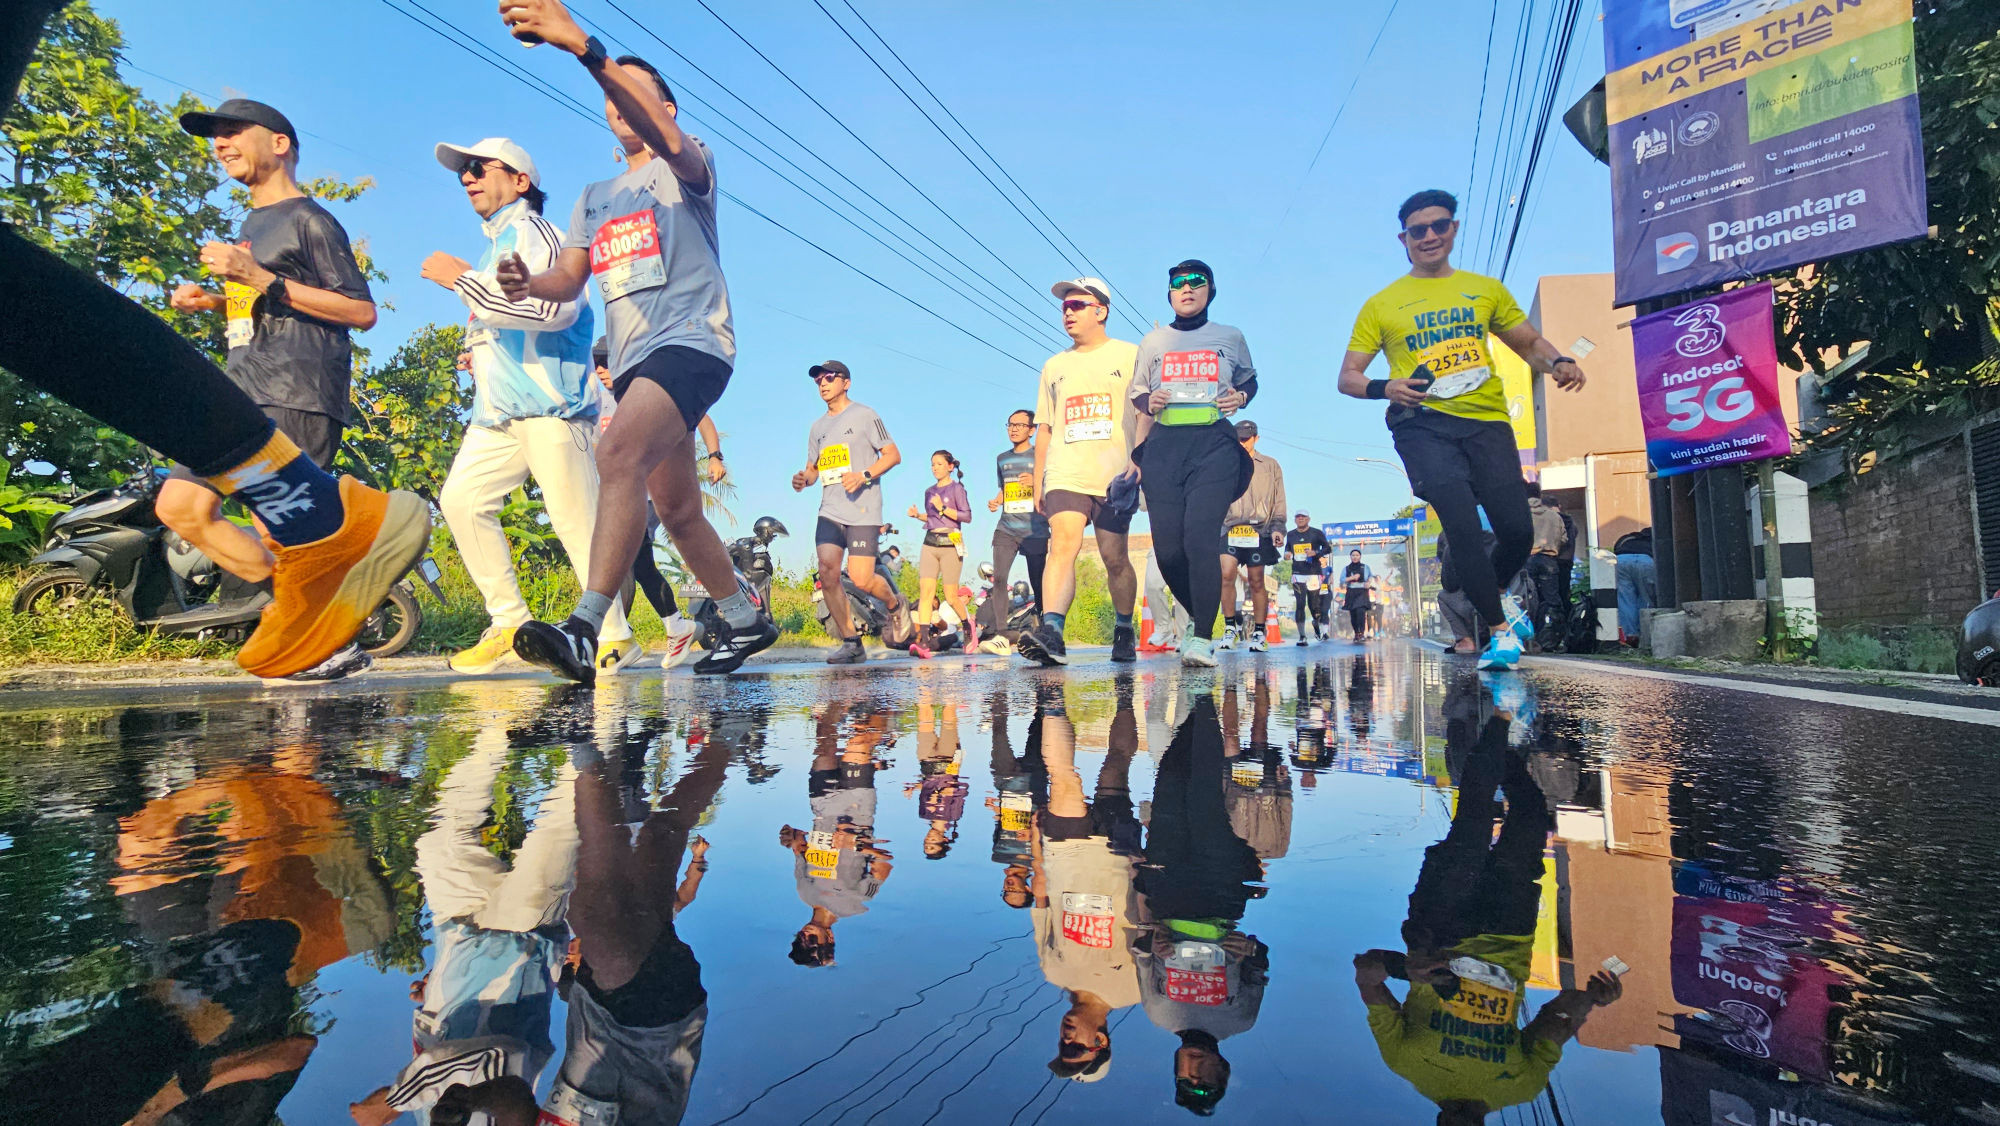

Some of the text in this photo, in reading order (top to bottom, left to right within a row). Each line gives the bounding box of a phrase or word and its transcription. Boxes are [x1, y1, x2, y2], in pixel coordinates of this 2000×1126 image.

[1641, 35, 1741, 85] MORE
[1754, 0, 1862, 40] THAN
[1668, 22, 1832, 94] A RACE
[1783, 123, 1876, 156] mandiri call 14000
[1774, 143, 1866, 175] bankmandiri.co.id
[1657, 161, 1746, 194] Livin' Call by Mandiri
[1670, 194, 1692, 206] MITA
[1693, 189, 1709, 199] 081
[1730, 176, 1755, 188] 4000
[611, 215, 650, 234] 10K-M
[1707, 187, 1867, 242] Danantara
[593, 228, 654, 265] A30085
[1708, 211, 1857, 262] Indonesia
[1414, 306, 1475, 331] VEGAN
[1405, 323, 1484, 352] RUNNERS
[1164, 361, 1217, 377] B31160
[1663, 355, 1744, 387] indosat
[1067, 403, 1111, 420] B31746
[1665, 377, 1755, 432] 5G
[1671, 433, 1767, 460] kini sudah hadir
[1690, 448, 1752, 465] di areamu.
